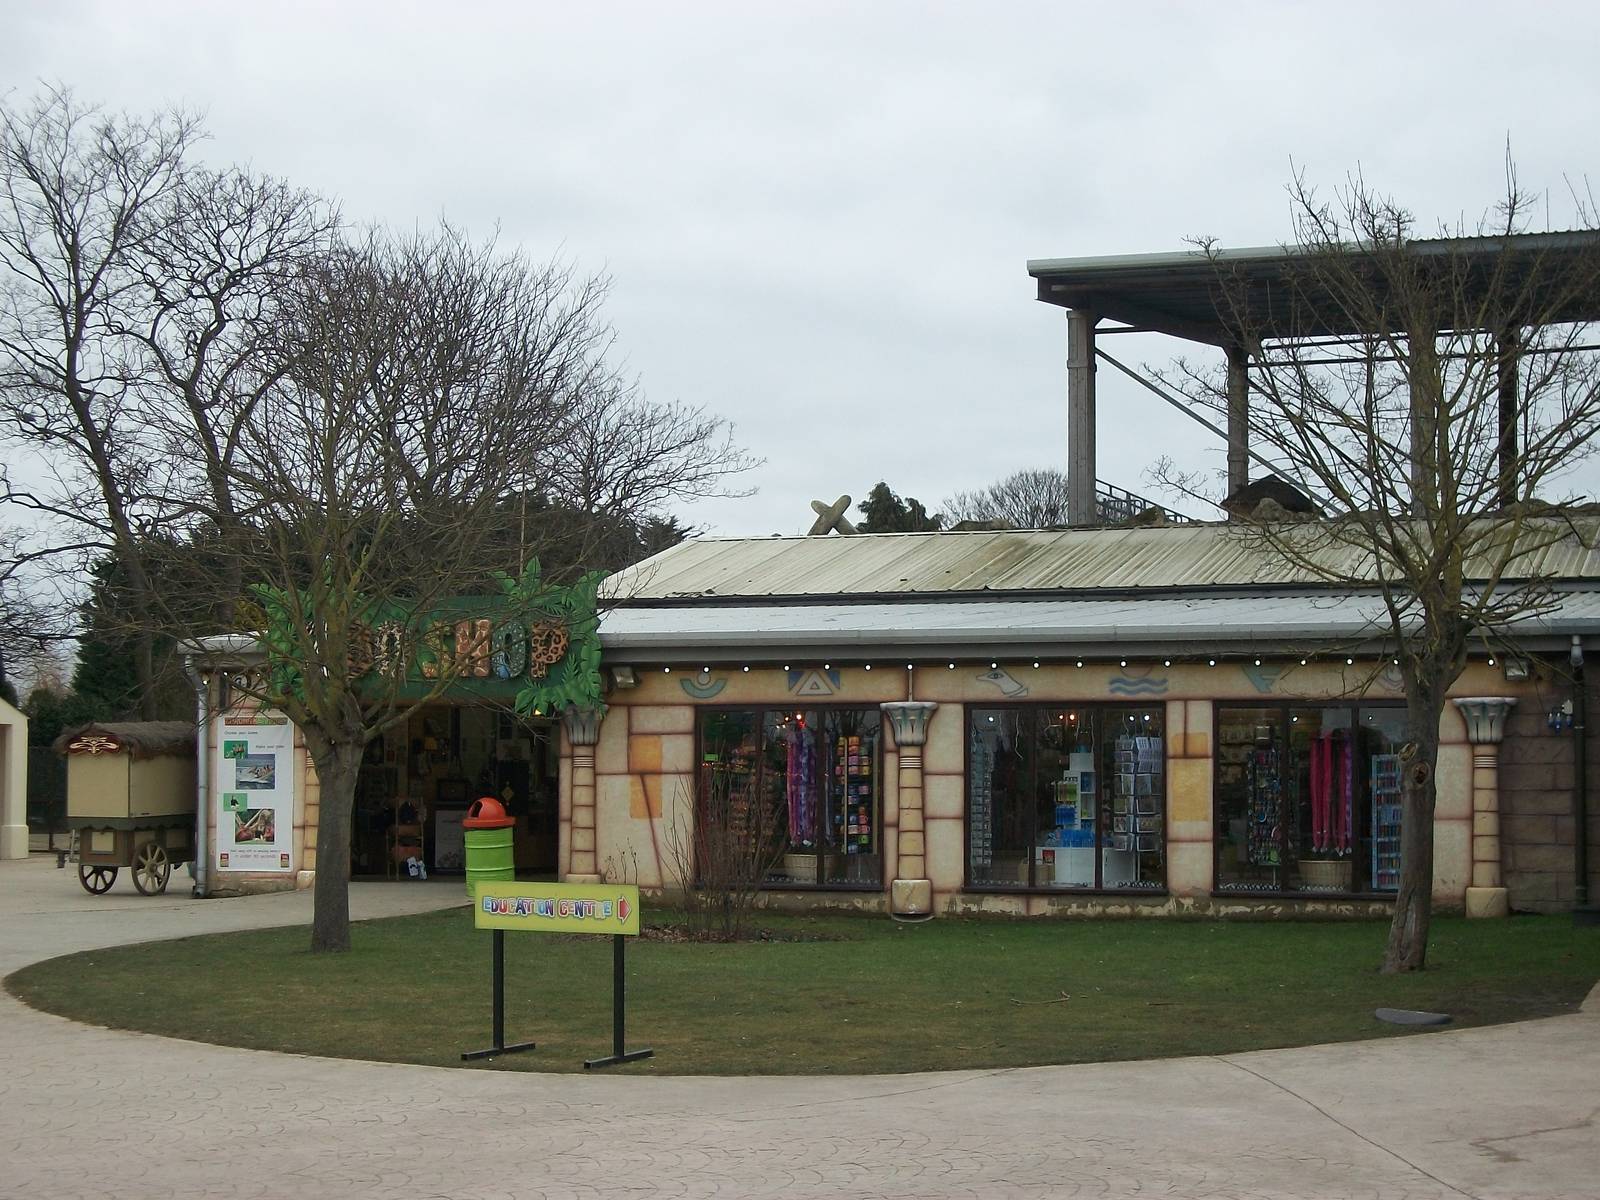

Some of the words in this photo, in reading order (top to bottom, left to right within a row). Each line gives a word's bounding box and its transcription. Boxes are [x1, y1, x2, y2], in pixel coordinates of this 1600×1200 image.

[419, 617, 570, 681] SHOP
[482, 896, 555, 917] EDUCATION
[559, 898, 613, 919] CENTRE
